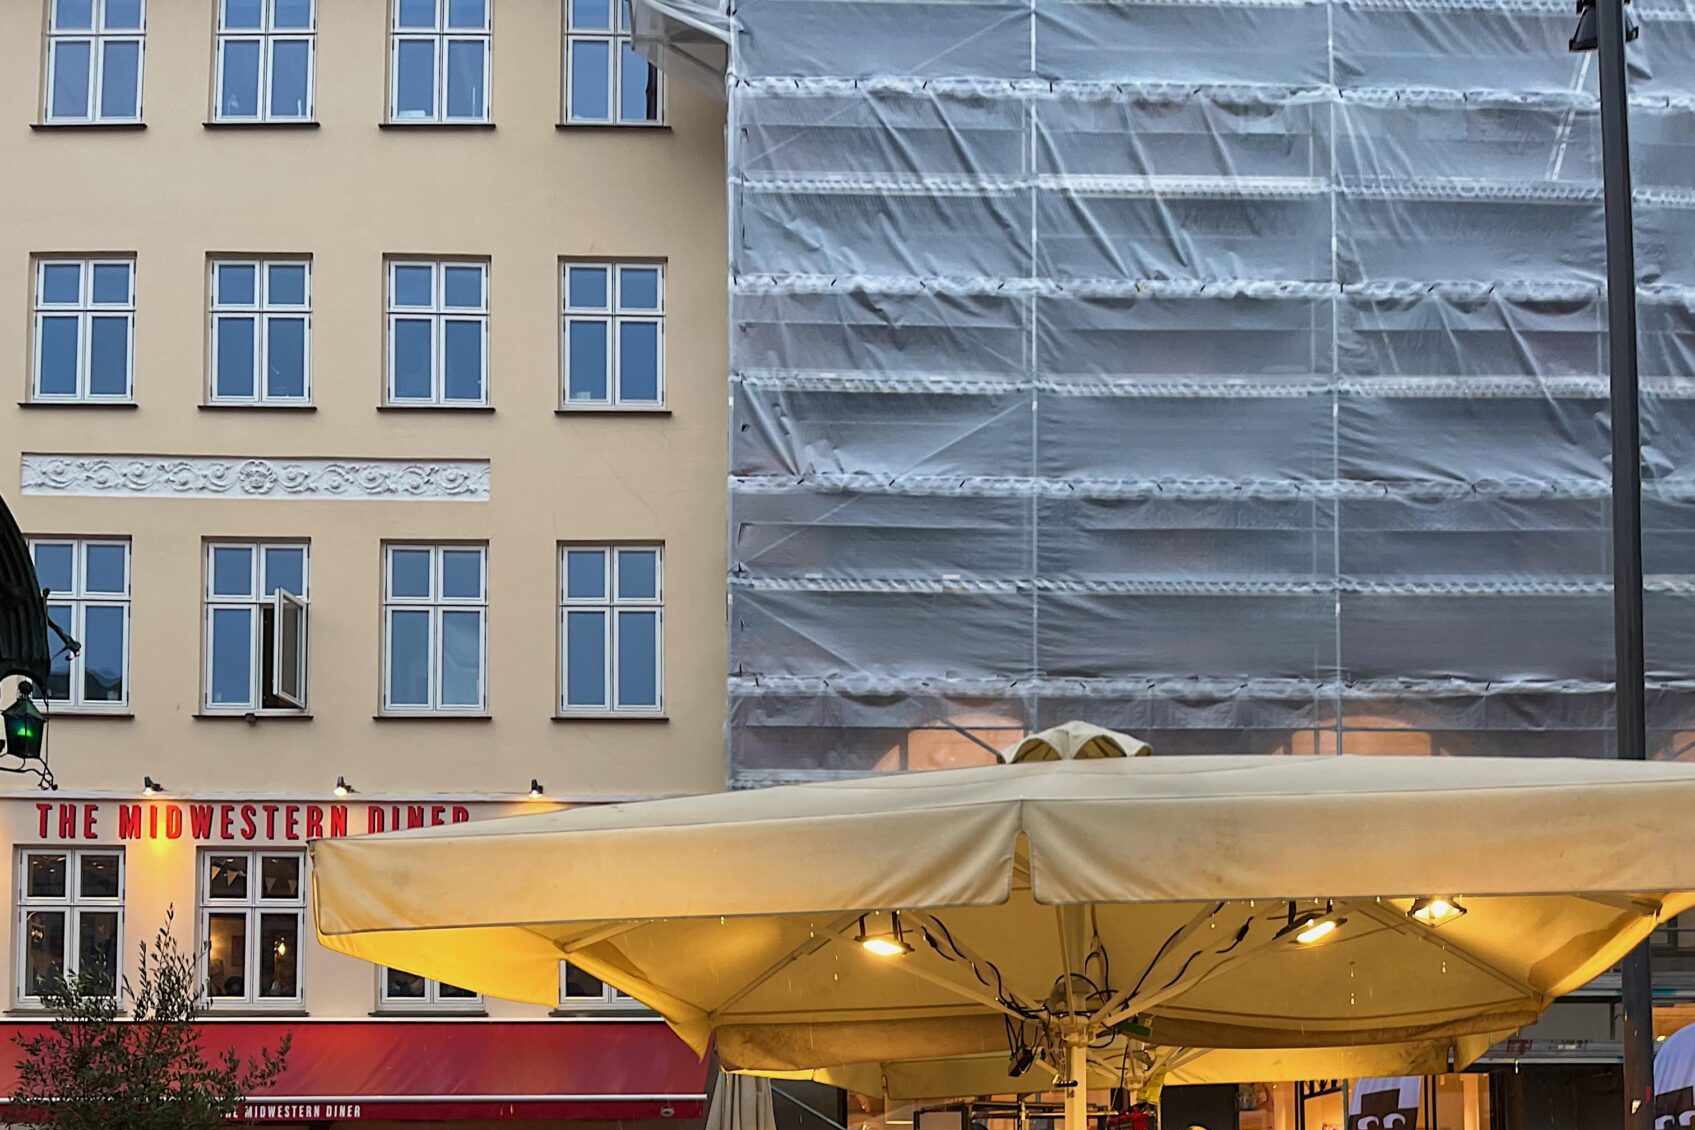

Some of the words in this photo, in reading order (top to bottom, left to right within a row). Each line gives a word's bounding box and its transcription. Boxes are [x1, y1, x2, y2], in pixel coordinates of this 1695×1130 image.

[36, 804, 98, 839] THE
[118, 804, 348, 840] MIDWESTERN
[244, 1104, 321, 1118] MIDWESTERN
[325, 1105, 361, 1118] DINER
